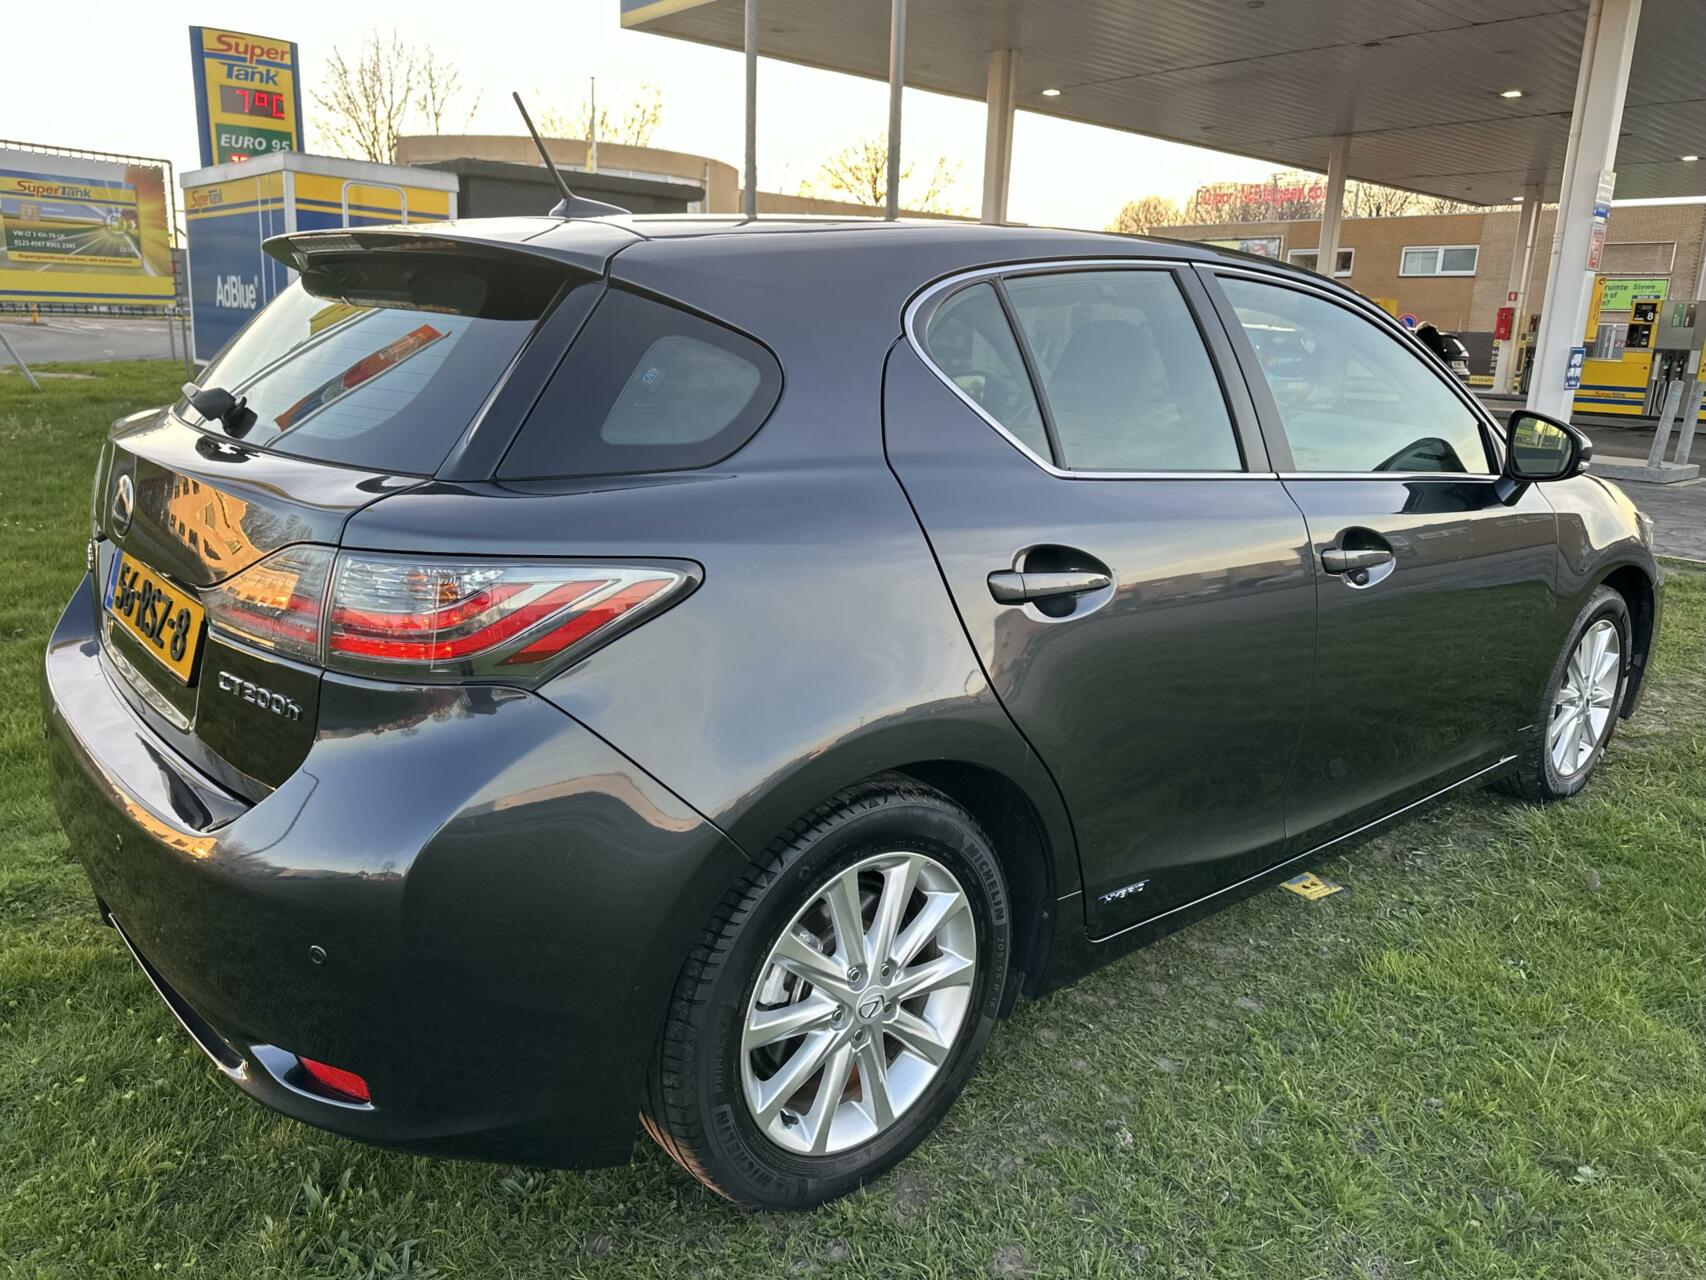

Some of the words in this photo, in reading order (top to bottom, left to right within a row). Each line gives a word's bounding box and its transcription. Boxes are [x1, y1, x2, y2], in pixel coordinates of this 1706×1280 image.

[206, 33, 289, 64] Super
[218, 61, 279, 86] Tank
[220, 133, 267, 150] EURO
[271, 139, 290, 152] 95
[14, 180, 92, 199] SuperTank
[1647, 312, 1654, 320] 8
[115, 562, 191, 662] 56-RSZ-8
[963, 842, 1005, 921] MICHELIN
[714, 1109, 776, 1188] MICHELIN
